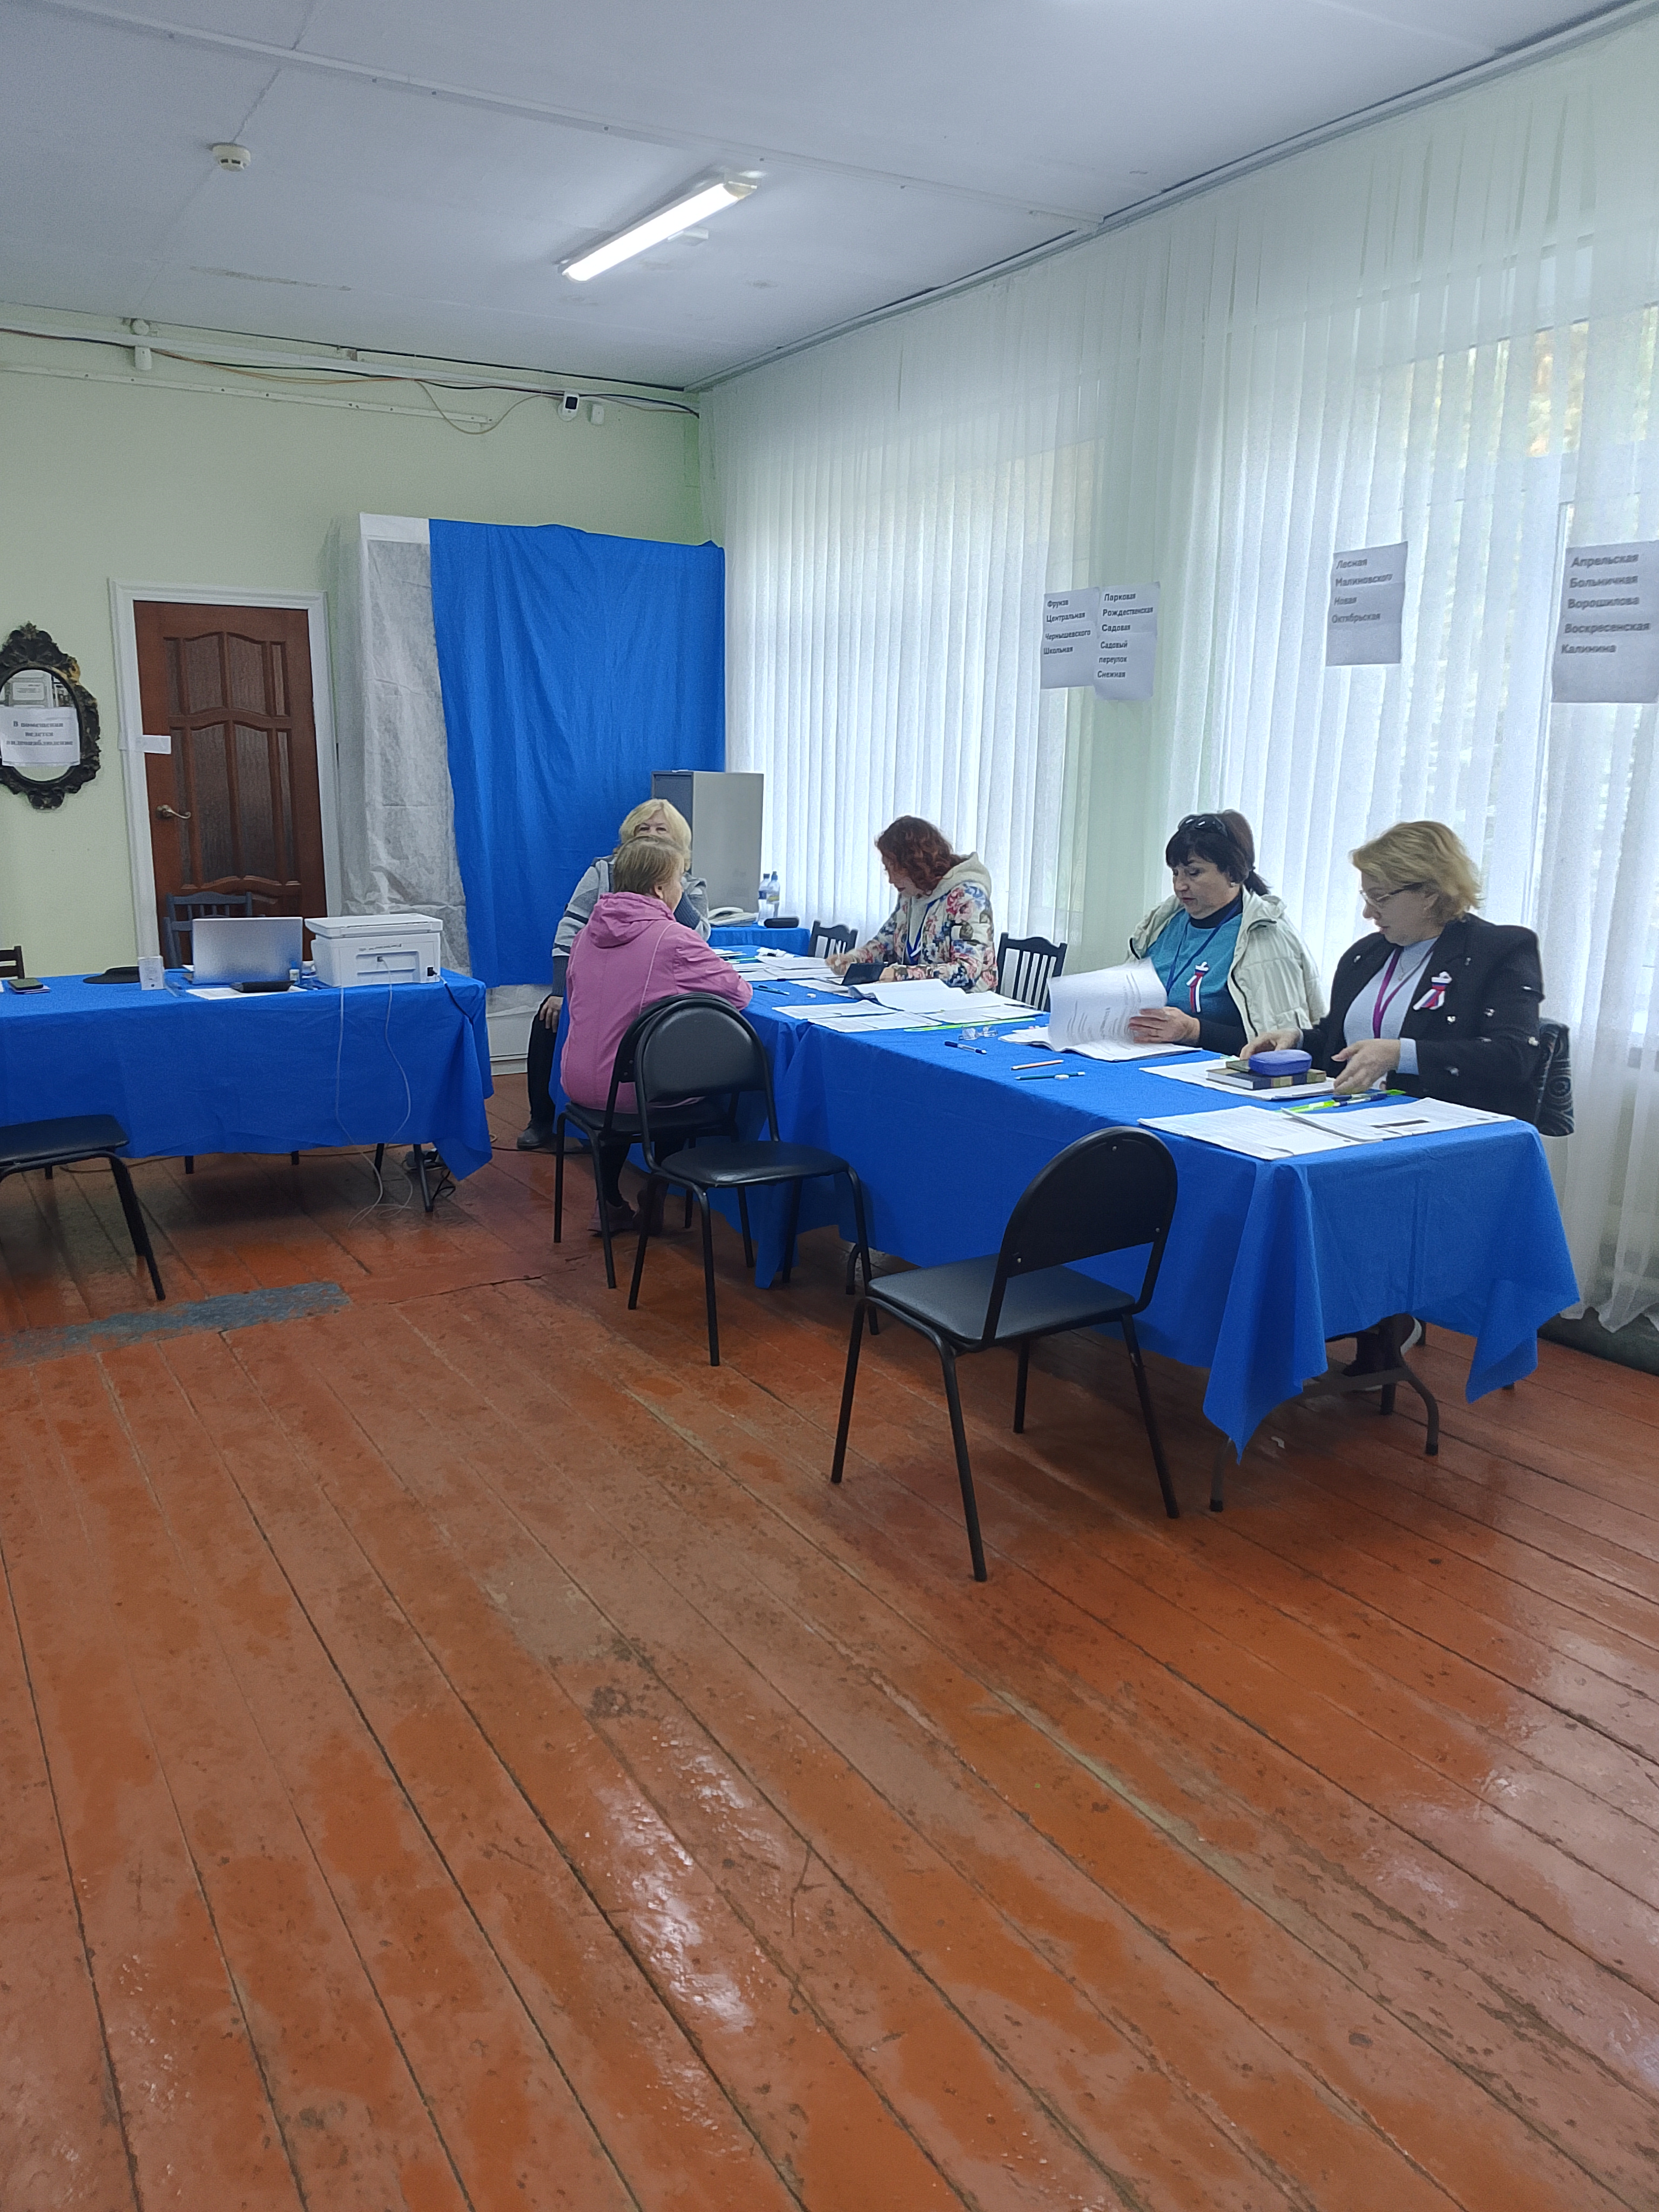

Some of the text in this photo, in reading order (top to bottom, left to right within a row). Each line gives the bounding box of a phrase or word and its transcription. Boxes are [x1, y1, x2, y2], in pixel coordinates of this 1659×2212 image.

[1336, 558, 1368, 570] Лесная
[1570, 554, 1639, 568] Апрельская
[1569, 575, 1638, 589] Больничная
[1104, 593, 1136, 603] Парковая
[1333, 596, 1358, 606] Новая
[1567, 596, 1640, 610] Ворошилова
[1103, 607, 1154, 617] Рождественская
[1046, 612, 1085, 623] Центральная
[1331, 613, 1381, 624] Октябрьская
[1102, 624, 1131, 632] Садовая
[1564, 623, 1651, 635] Воскресенская
[1045, 630, 1091, 641] Чернышевского
[1100, 640, 1128, 649] Садовый
[1043, 646, 1073, 655] Школьная
[1098, 656, 1128, 665] переулок
[1097, 670, 1125, 678] Снежная
